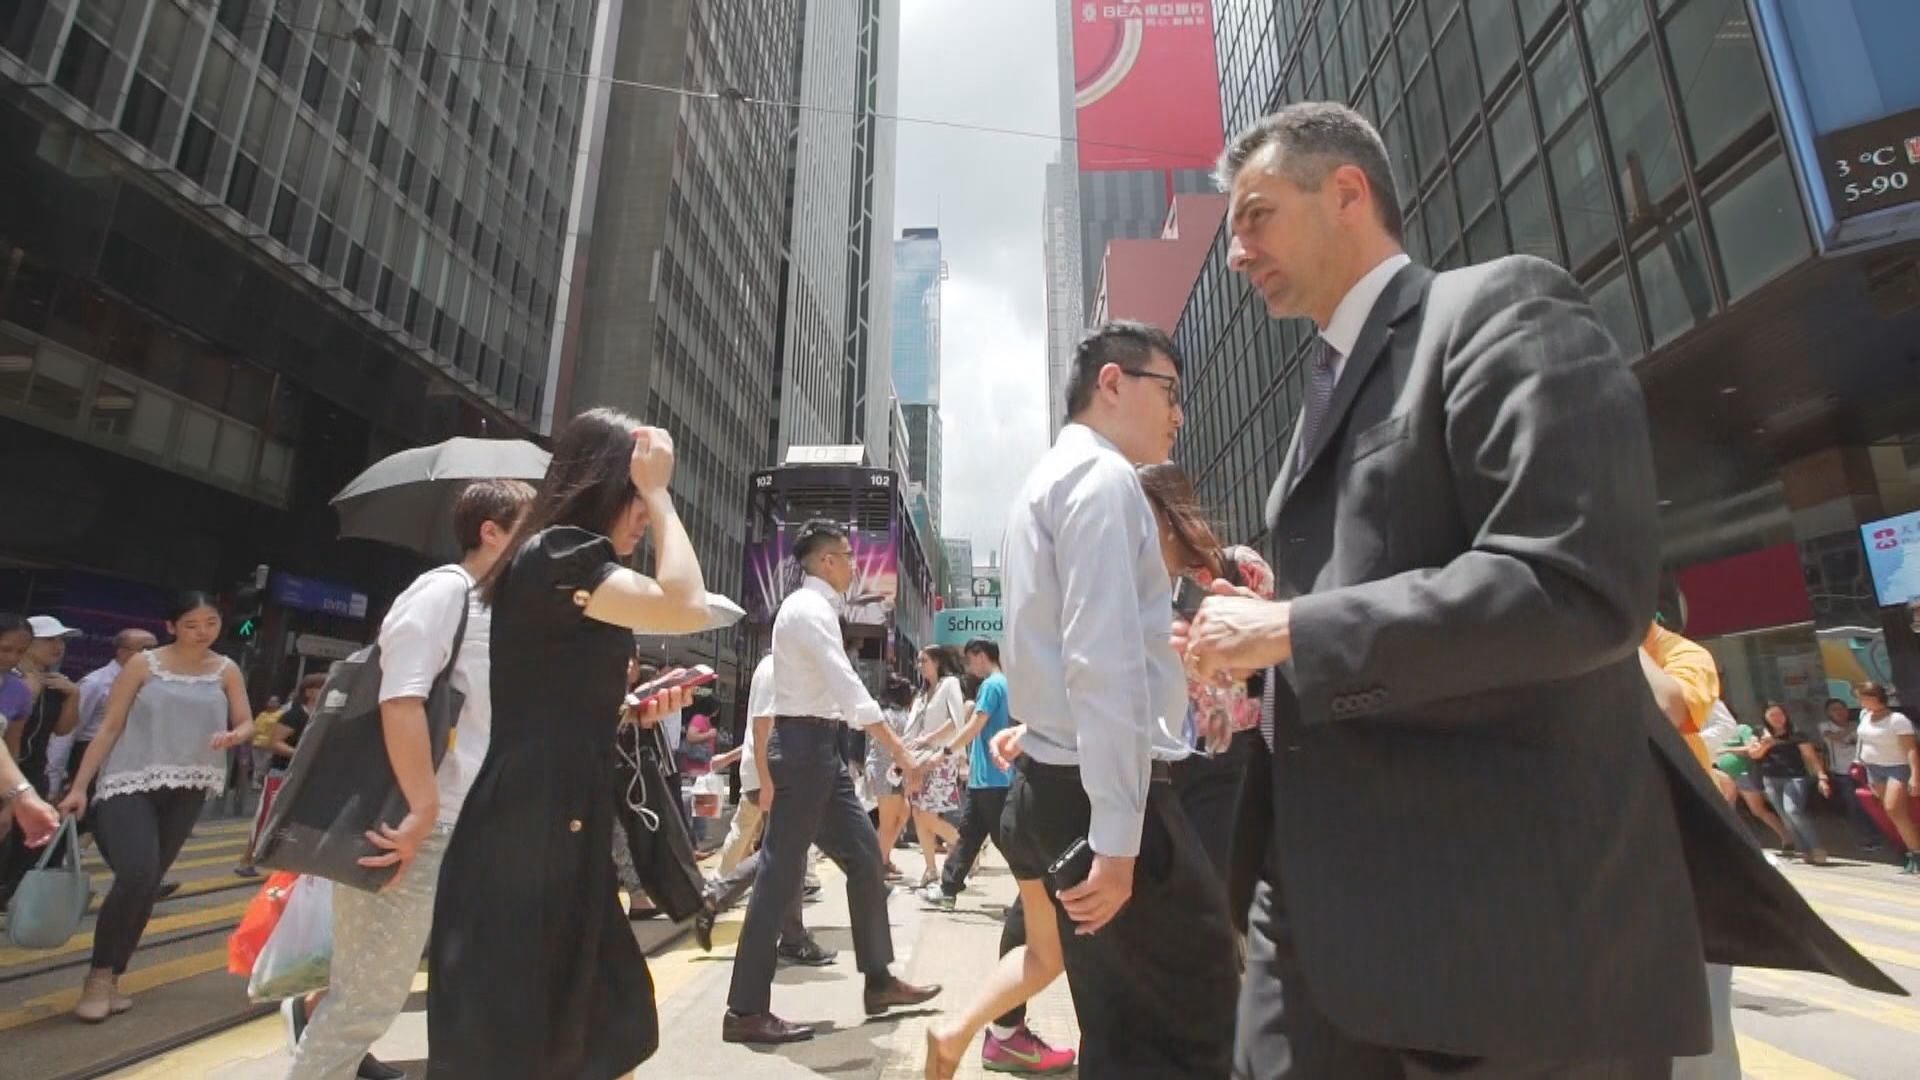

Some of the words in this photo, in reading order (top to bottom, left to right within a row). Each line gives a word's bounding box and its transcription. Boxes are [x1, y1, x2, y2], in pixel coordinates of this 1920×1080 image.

[1103, 6, 1143, 17] BEA
[1835, 160, 1851, 177] 3
[1845, 171, 1909, 201] 5-90
[756, 475, 773, 488] 102
[870, 474, 890, 487] 102
[948, 615, 1003, 632] Schrod
